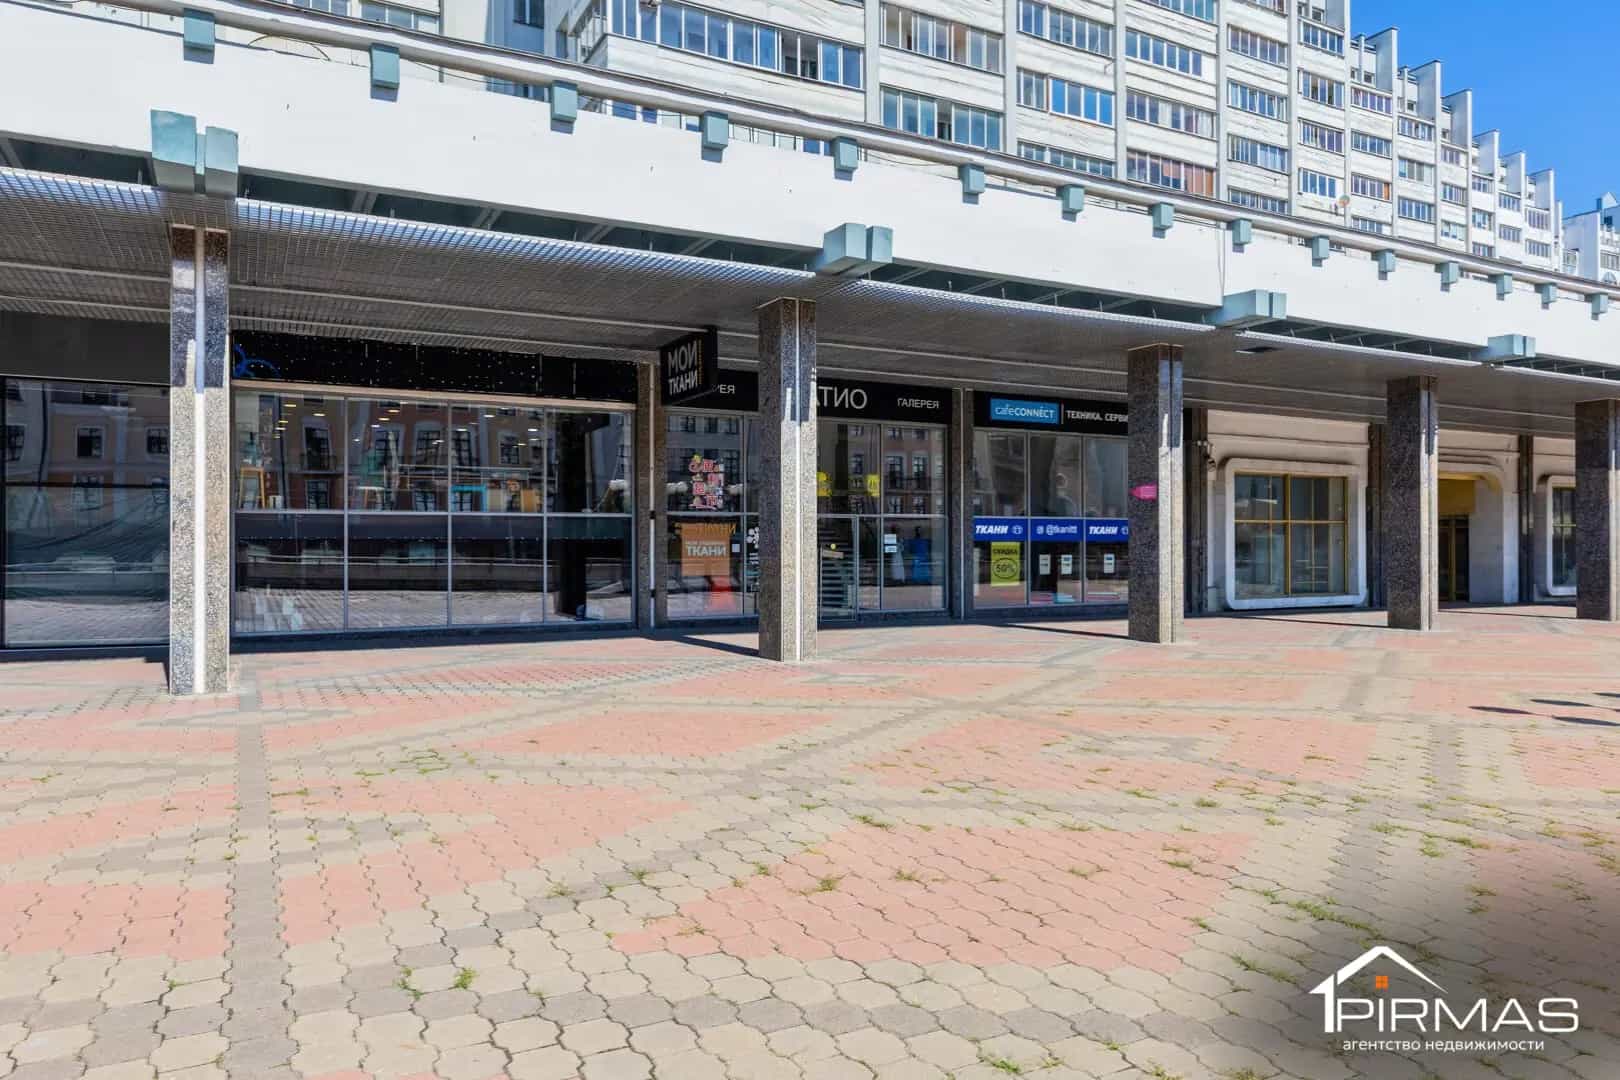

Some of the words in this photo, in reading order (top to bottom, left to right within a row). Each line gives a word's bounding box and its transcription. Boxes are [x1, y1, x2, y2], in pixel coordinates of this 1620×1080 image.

[668, 340, 697, 376] МОИ
[668, 370, 698, 396] ТКАНИ
[816, 385, 868, 410] ТИО
[897, 398, 940, 409] ГАЛЕРЕЯ
[975, 525, 1009, 535] ТКАНИ
[1088, 526, 1118, 535] ТКАНИ
[687, 544, 726, 557] ТКАНИ
